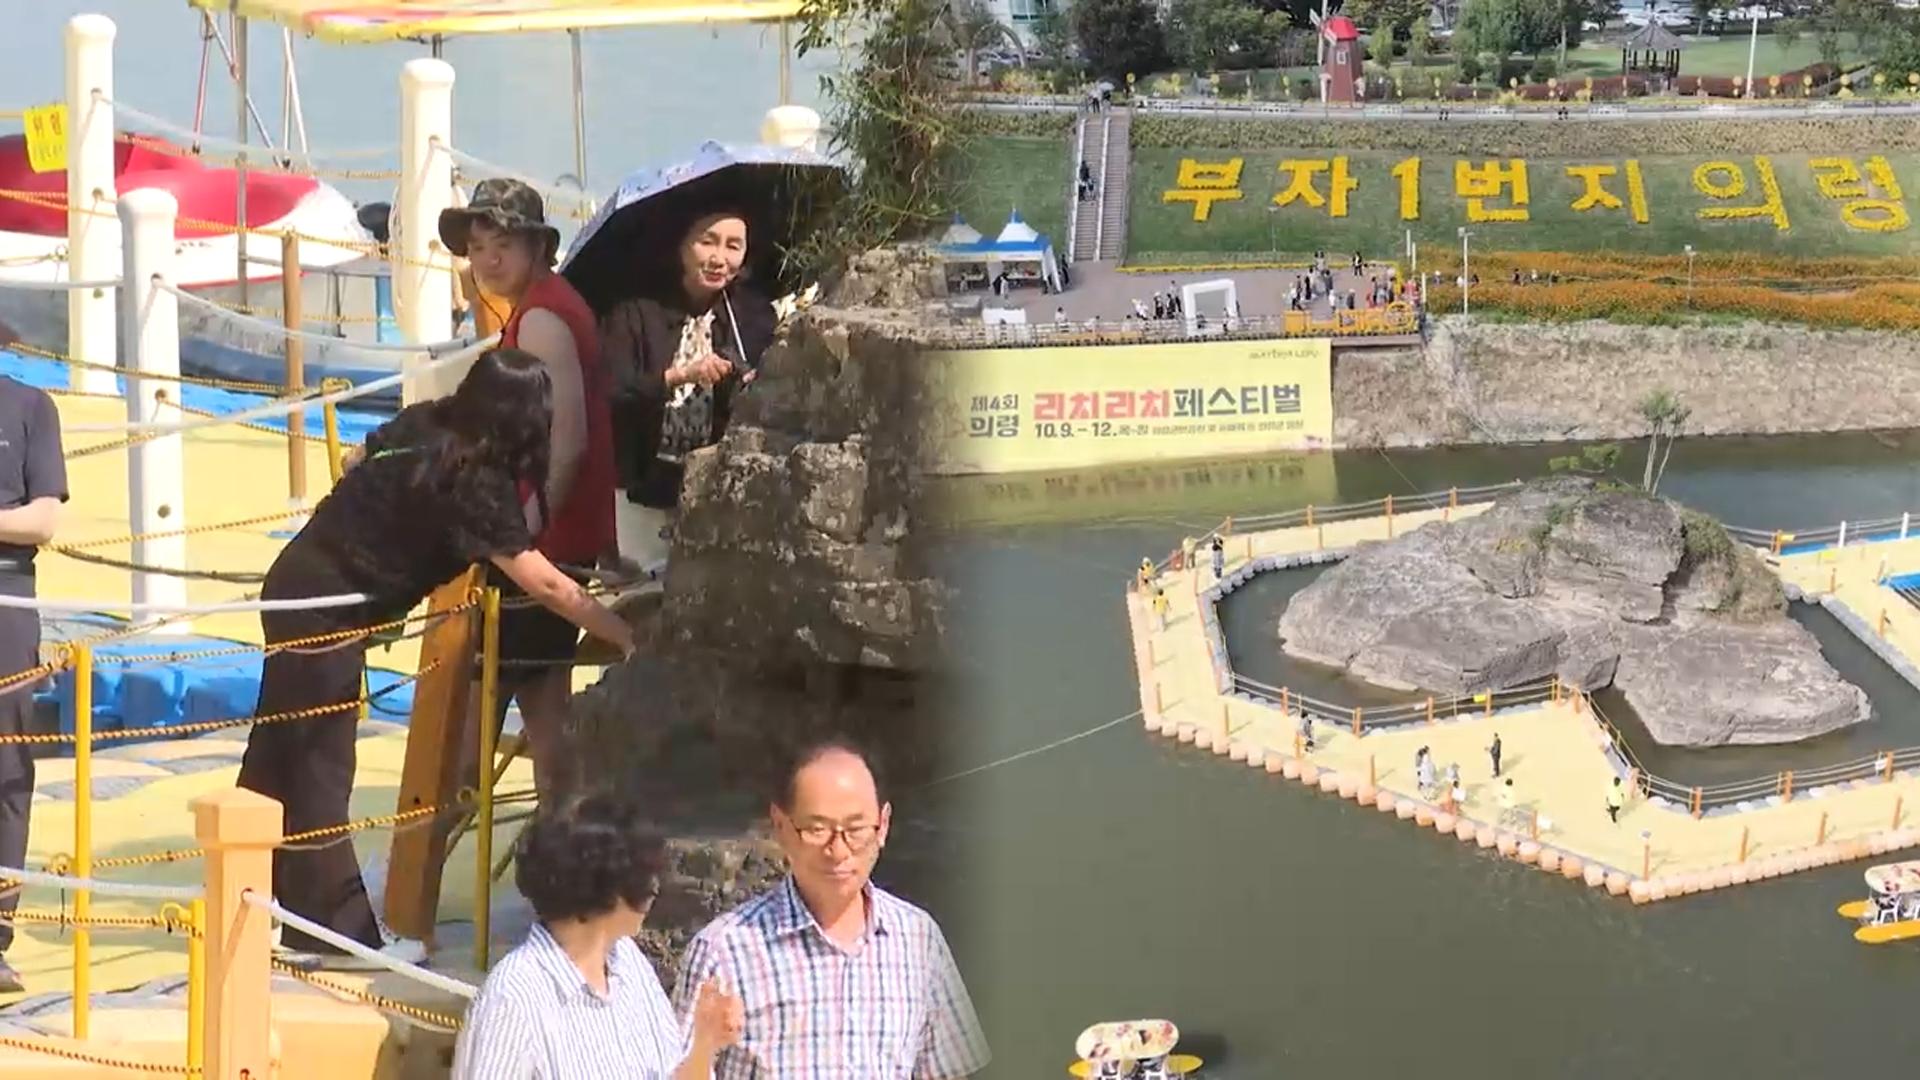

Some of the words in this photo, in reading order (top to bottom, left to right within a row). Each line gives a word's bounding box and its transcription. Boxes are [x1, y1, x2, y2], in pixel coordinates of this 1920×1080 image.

[970, 394, 1019, 412] 제4회
[1034, 384, 1302, 420] 리치리치페스티벌
[969, 415, 1019, 437] 의령
